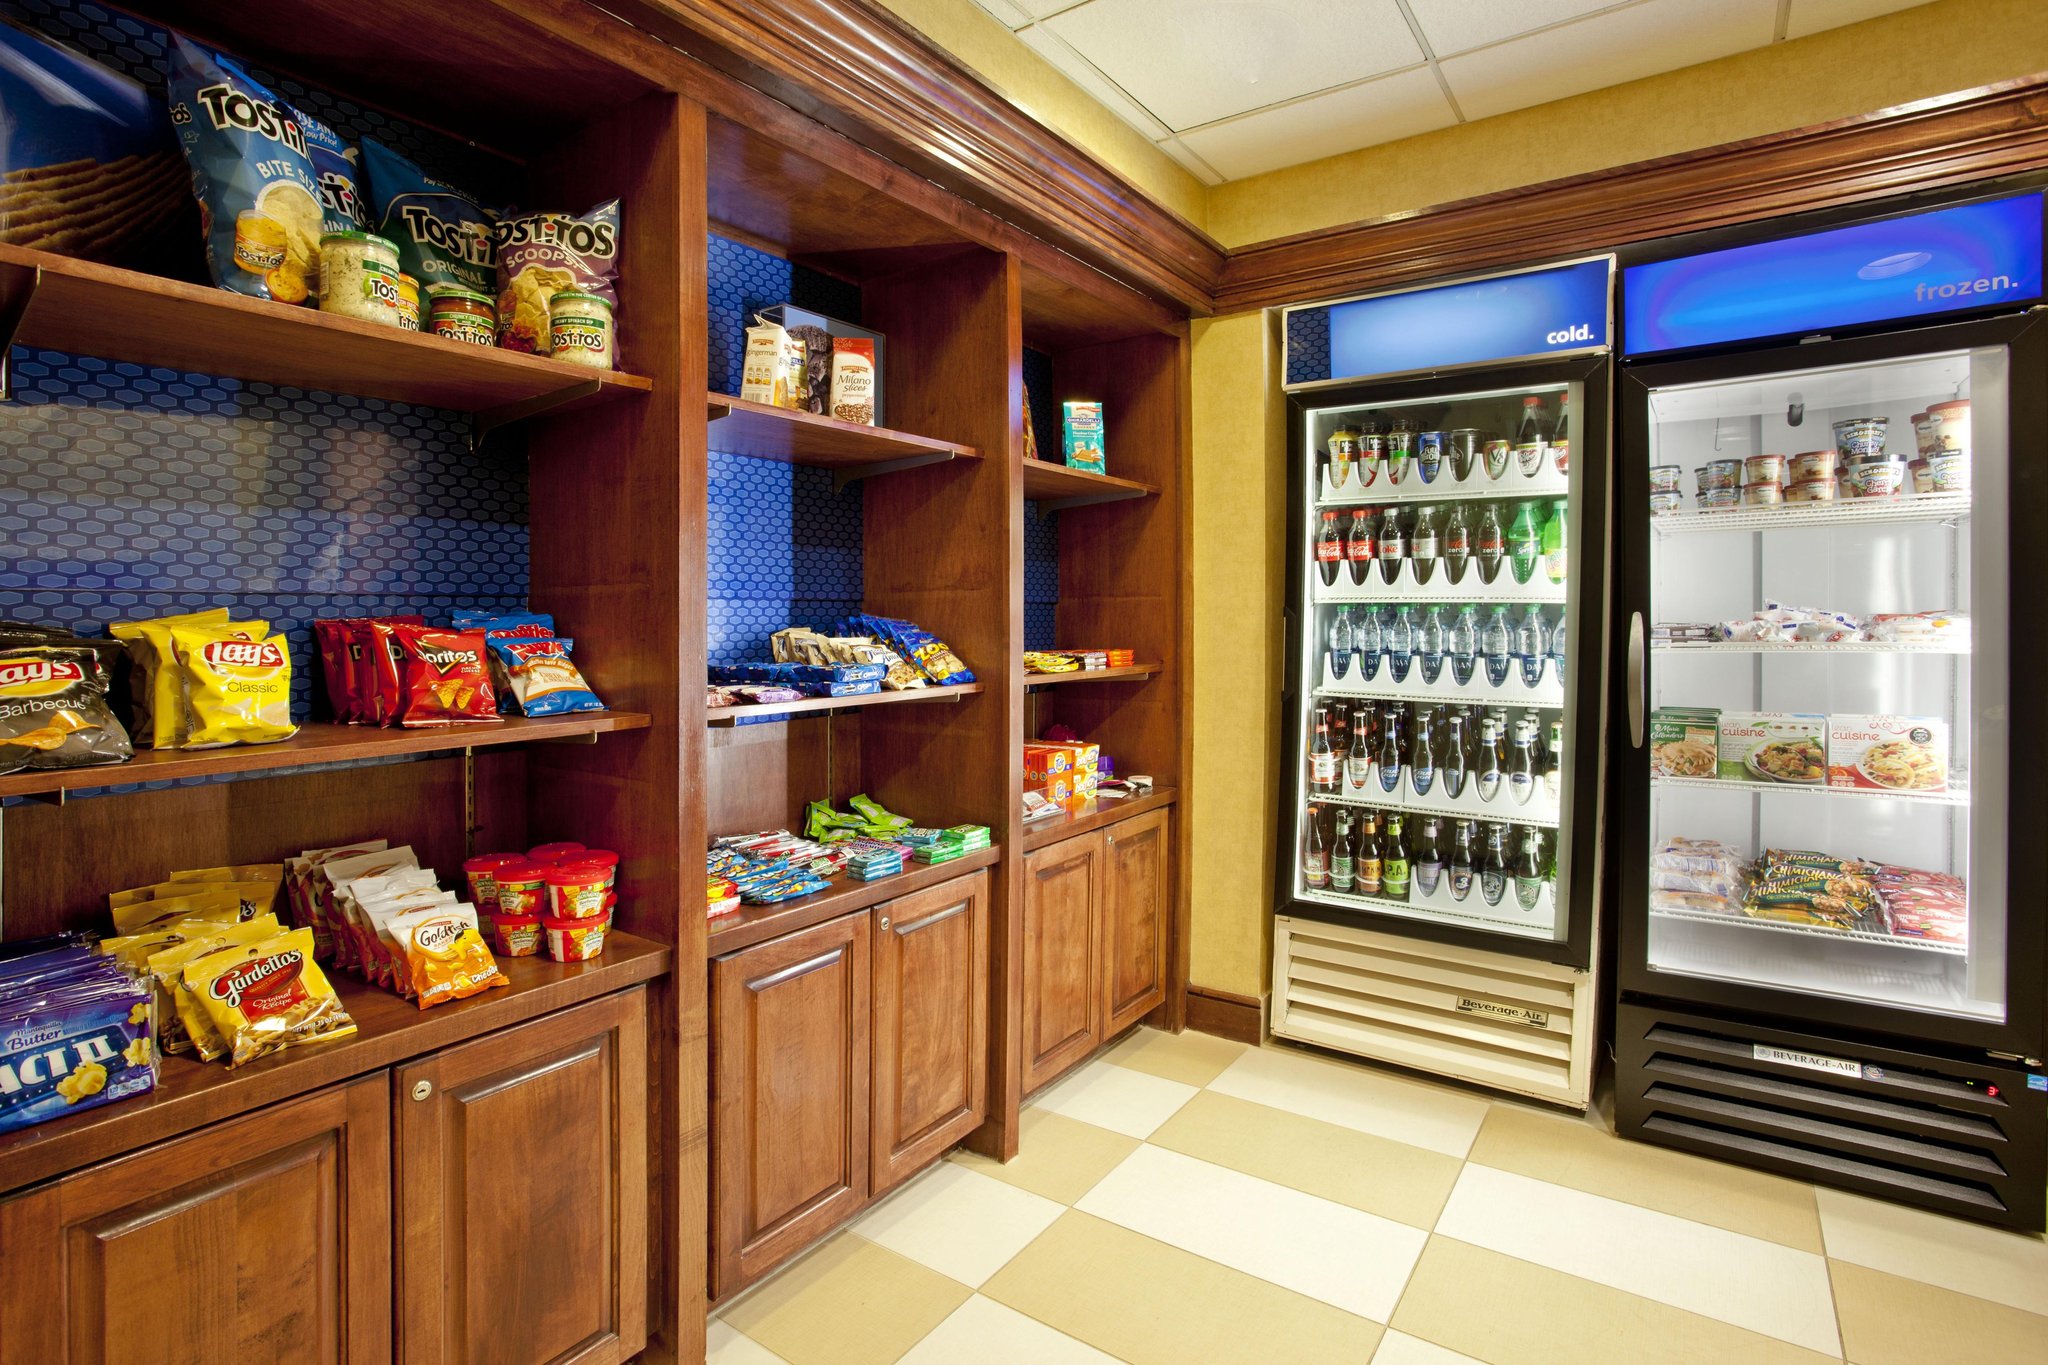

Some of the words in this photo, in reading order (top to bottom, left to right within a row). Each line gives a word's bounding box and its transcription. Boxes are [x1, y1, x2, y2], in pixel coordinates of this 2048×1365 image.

[256, 160, 295, 178] BITE
[422, 259, 487, 285] ORIGINAL
[1914, 274, 2018, 302] frozen.
[1547, 323, 1594, 344] cold.
[836, 375, 871, 385] Milano
[211, 641, 280, 667] Lay's
[914, 642, 949, 661] ZOO
[227, 682, 278, 693] Classic
[1721, 728, 1766, 737] cuisine
[1831, 731, 1880, 741] cuisine
[420, 921, 470, 947] Goldfish
[252, 988, 293, 1008] Original
[257, 997, 293, 1011] Recipe
[14, 1021, 62, 1037] Mantequilla
[6, 1029, 62, 1051] Butter
[1772, 1051, 1857, 1073] BEVERAGE-AIR
